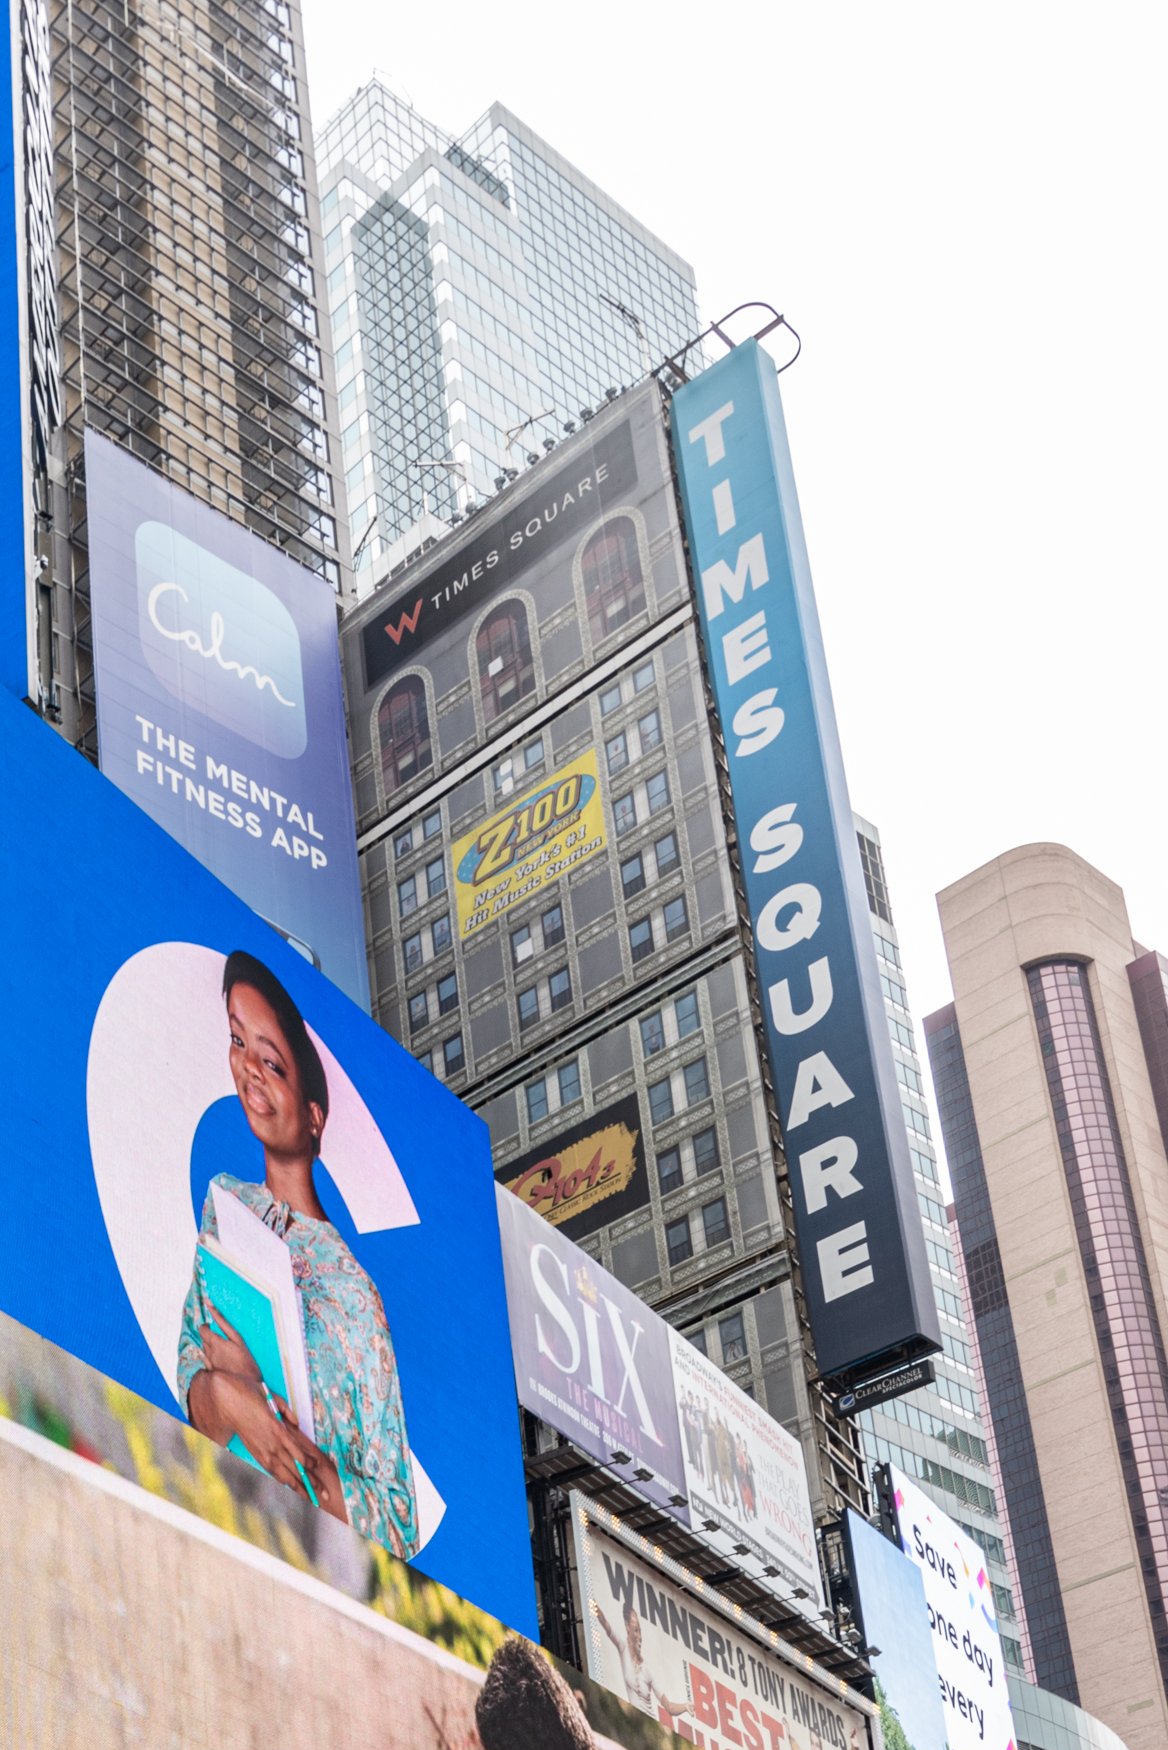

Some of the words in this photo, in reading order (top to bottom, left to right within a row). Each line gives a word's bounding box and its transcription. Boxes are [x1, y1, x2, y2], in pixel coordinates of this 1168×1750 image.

[384, 597, 424, 646] W
[430, 549, 500, 610] TIMES
[509, 462, 610, 550] SQUARE
[147, 581, 297, 708] Calm
[135, 714, 197, 770] THE
[206, 754, 324, 841] MENTAL
[136, 749, 263, 839] FITNESS
[270, 827, 329, 870] APP
[473, 773, 582, 887] Z100
[547, 808, 582, 841] YORK
[464, 908, 490, 933] Hit
[491, 875, 542, 916] Music
[545, 836, 603, 880] Station
[473, 876, 512, 911] New
[515, 843, 562, 882] York's
[565, 824, 587, 849] #1
[687, 400, 786, 757] TIMES
[750, 801, 874, 1304] SQUARE
[529, 1243, 665, 1448] SIX
[759, 1494, 813, 1558] WRONG
[912, 1523, 958, 1590] Save
[601, 1551, 737, 1680] WINNER!
[735, 1646, 749, 1687] 8
[748, 1654, 788, 1716] TONY
[962, 1629, 994, 1688] day
